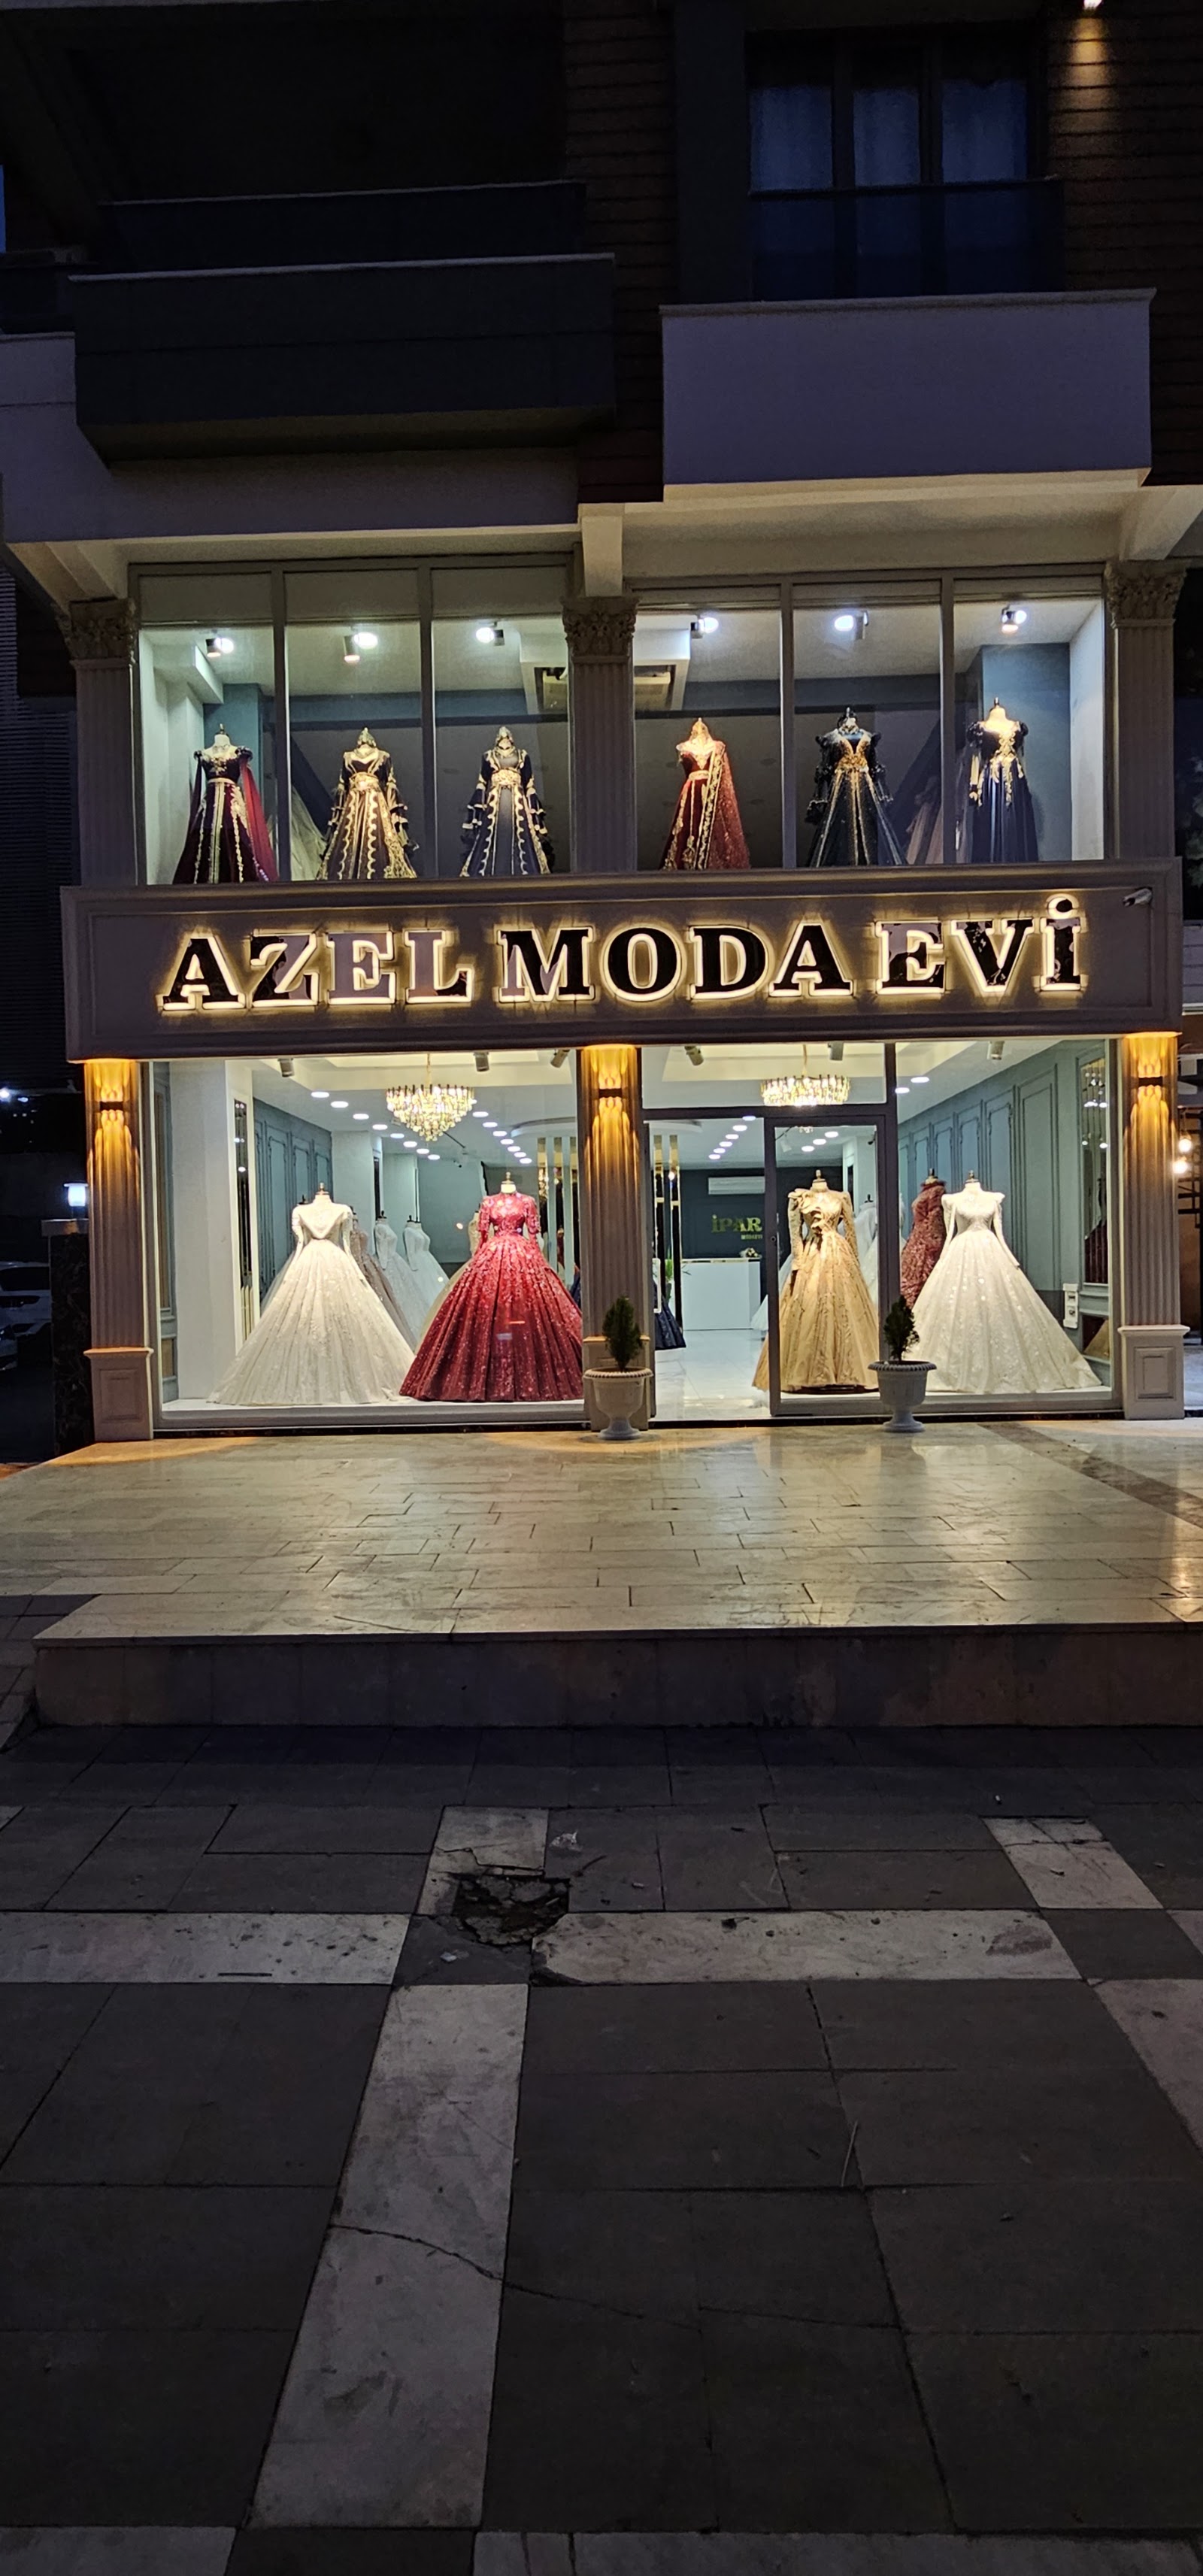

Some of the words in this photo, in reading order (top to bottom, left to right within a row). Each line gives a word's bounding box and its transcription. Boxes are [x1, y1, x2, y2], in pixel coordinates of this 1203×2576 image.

[157, 929, 474, 1011] AZEL
[496, 920, 854, 1003] MODA
[874, 893, 1084, 995] EVİ
